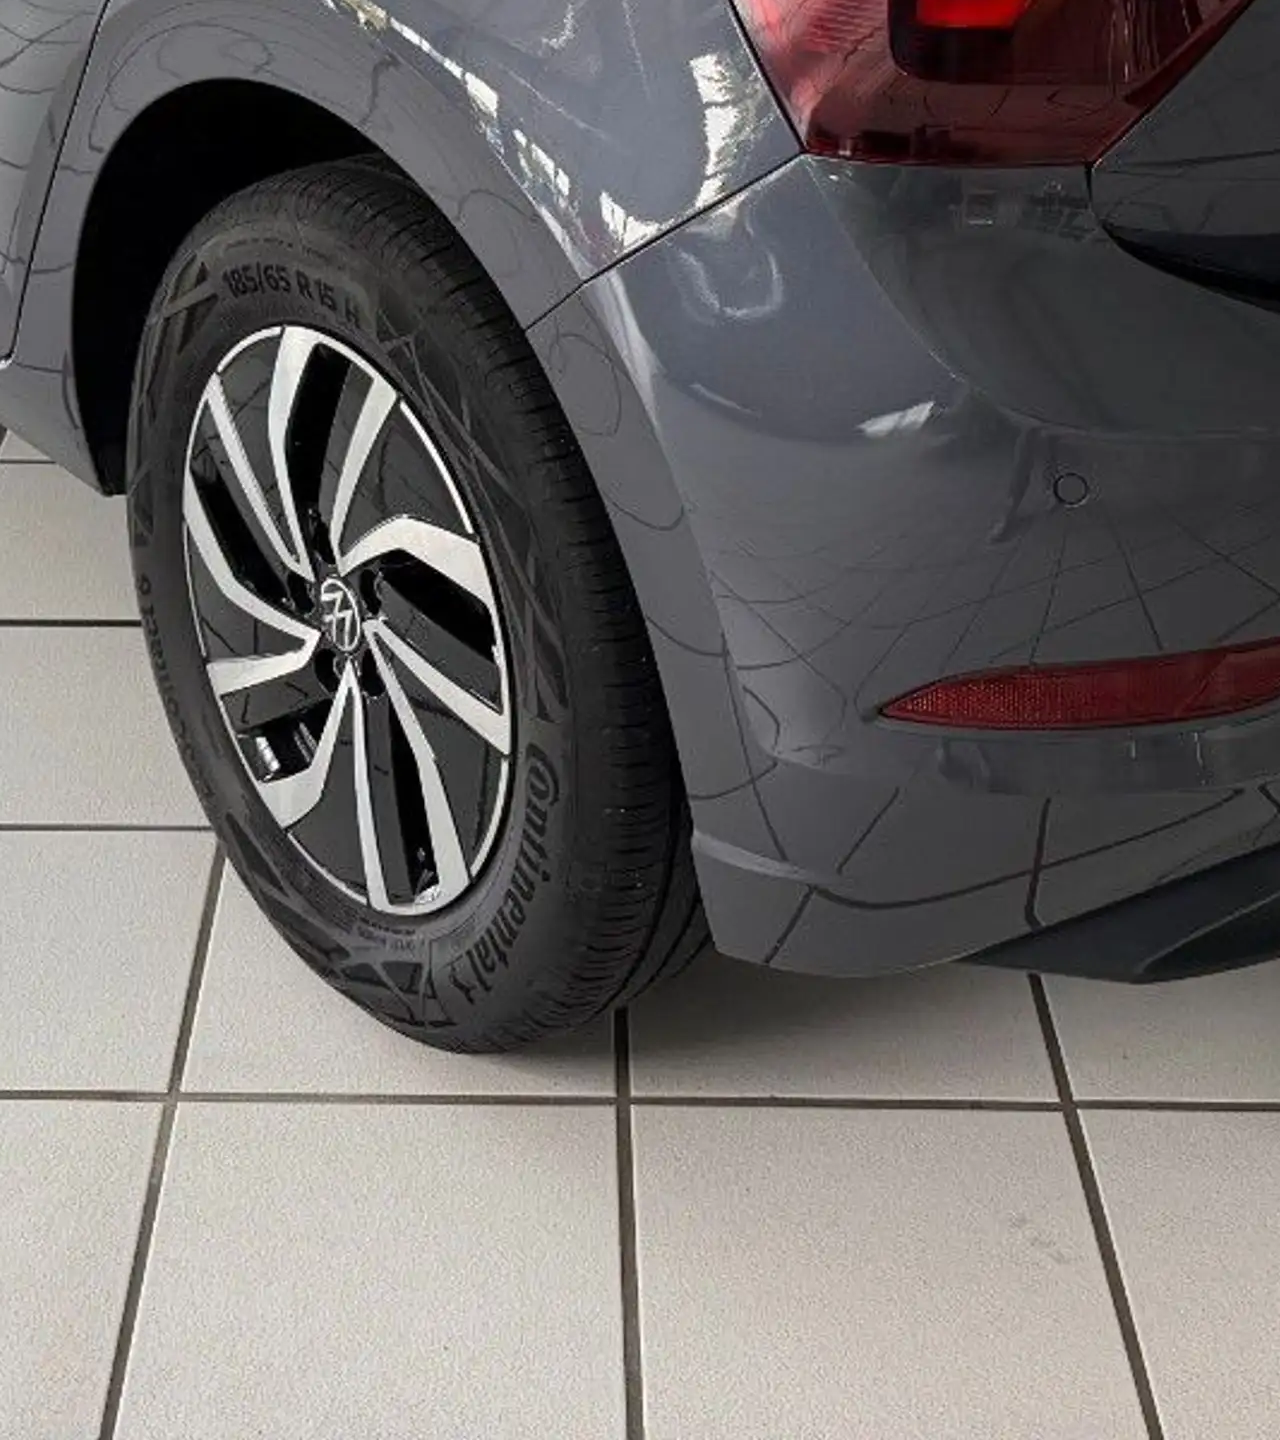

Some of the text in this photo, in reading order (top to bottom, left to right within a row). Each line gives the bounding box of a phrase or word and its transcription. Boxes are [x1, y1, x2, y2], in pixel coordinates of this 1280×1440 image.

[222, 261, 291, 299] 185/65
[295, 269, 314, 301] R
[466, 742, 559, 993] Continental
